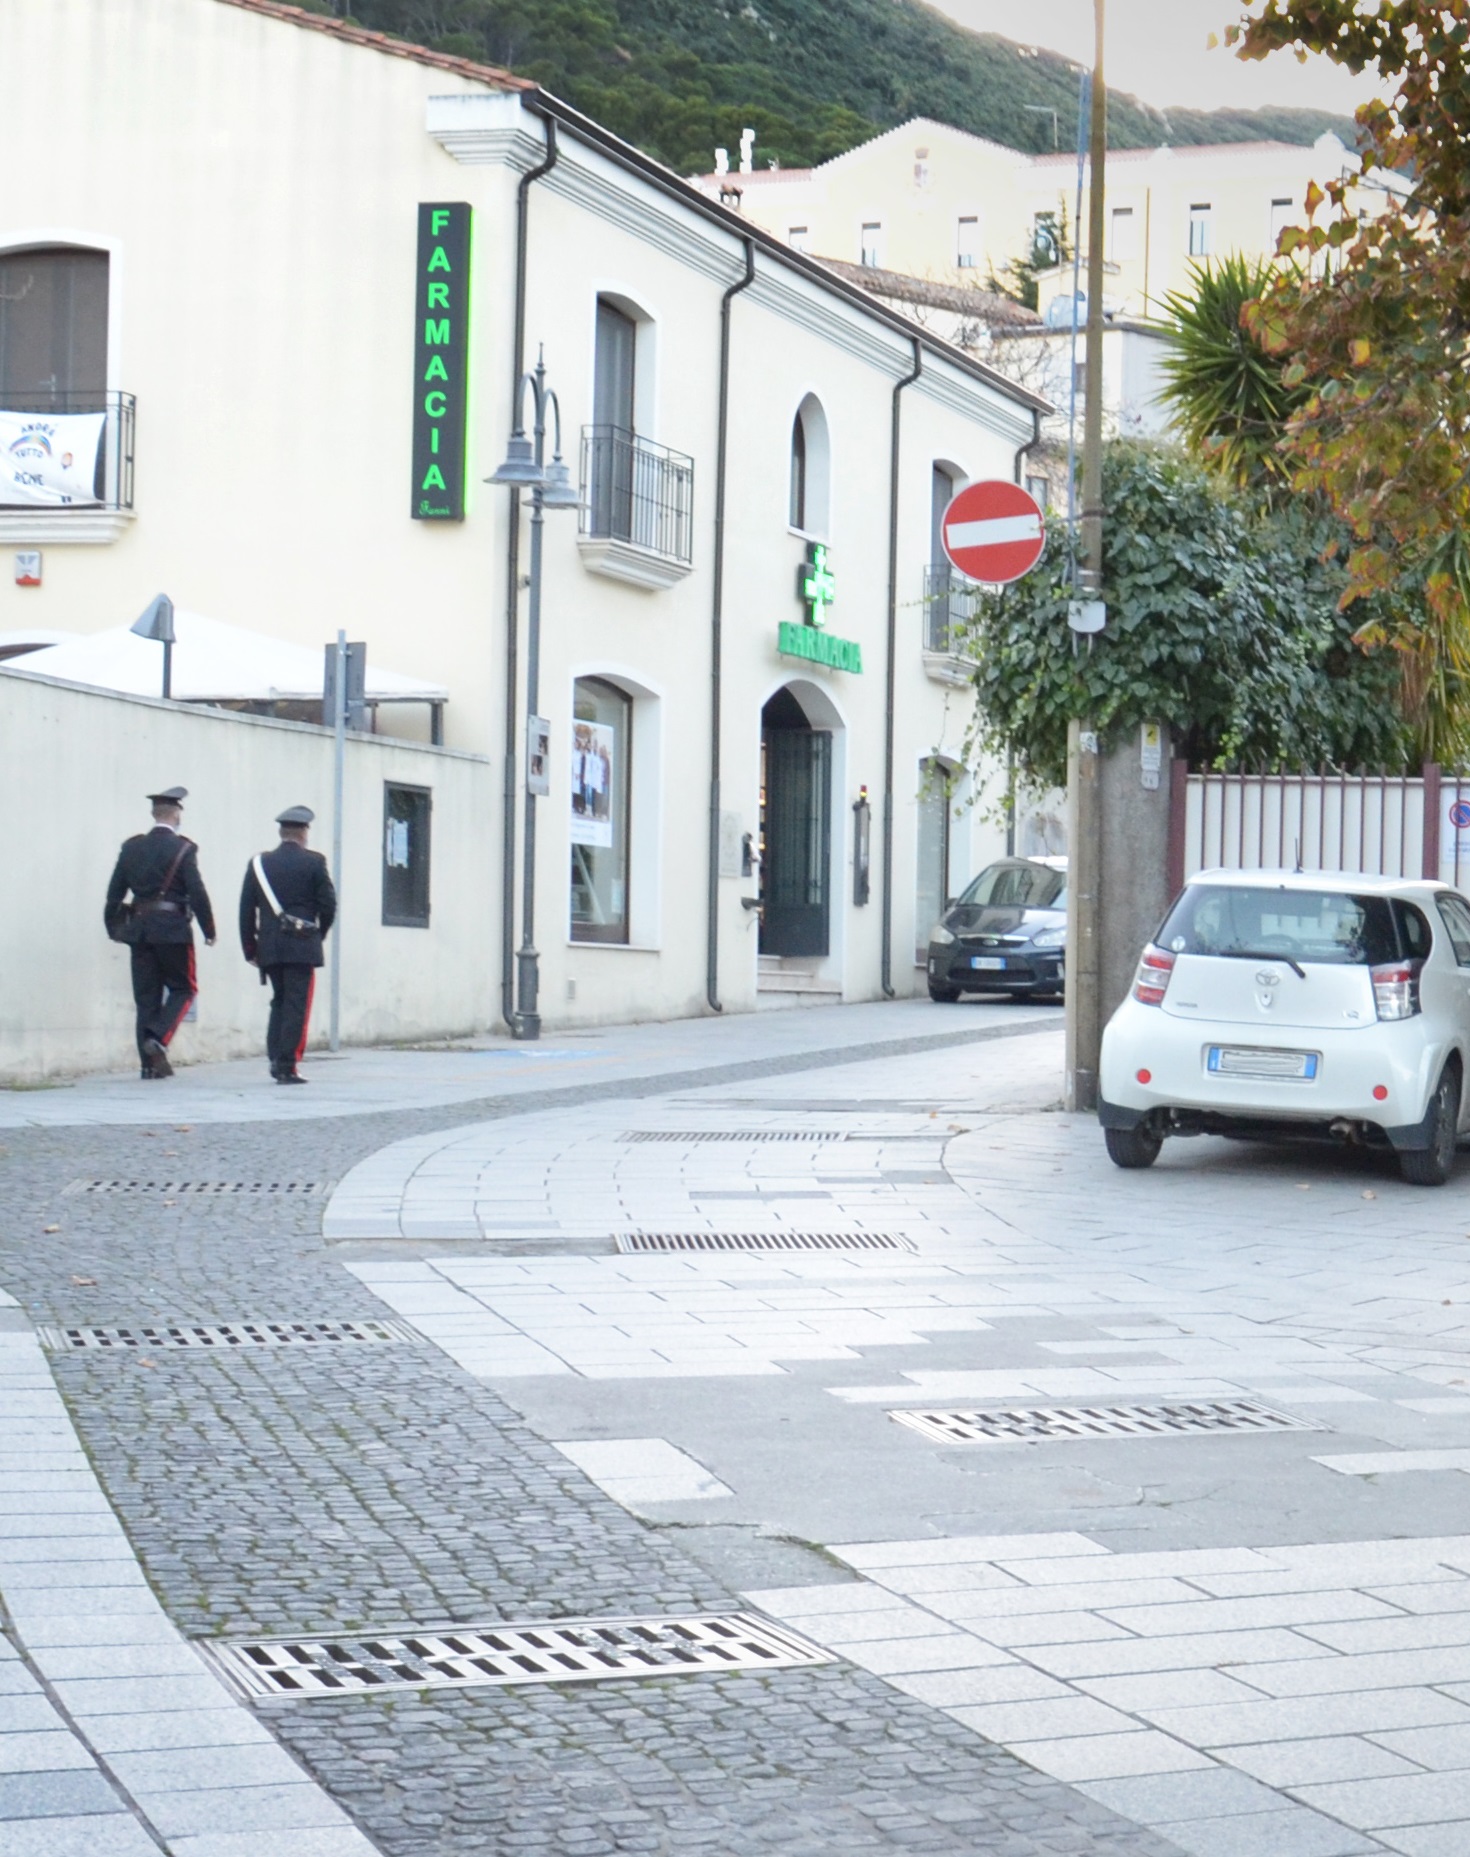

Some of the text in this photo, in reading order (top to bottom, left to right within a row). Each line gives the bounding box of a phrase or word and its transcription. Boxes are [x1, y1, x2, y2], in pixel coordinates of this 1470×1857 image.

[421, 209, 451, 490] FARMACIA
[15, 447, 44, 458] TUTTO
[14, 471, 44, 486] BENE
[780, 621, 863, 675] FARMACIA
